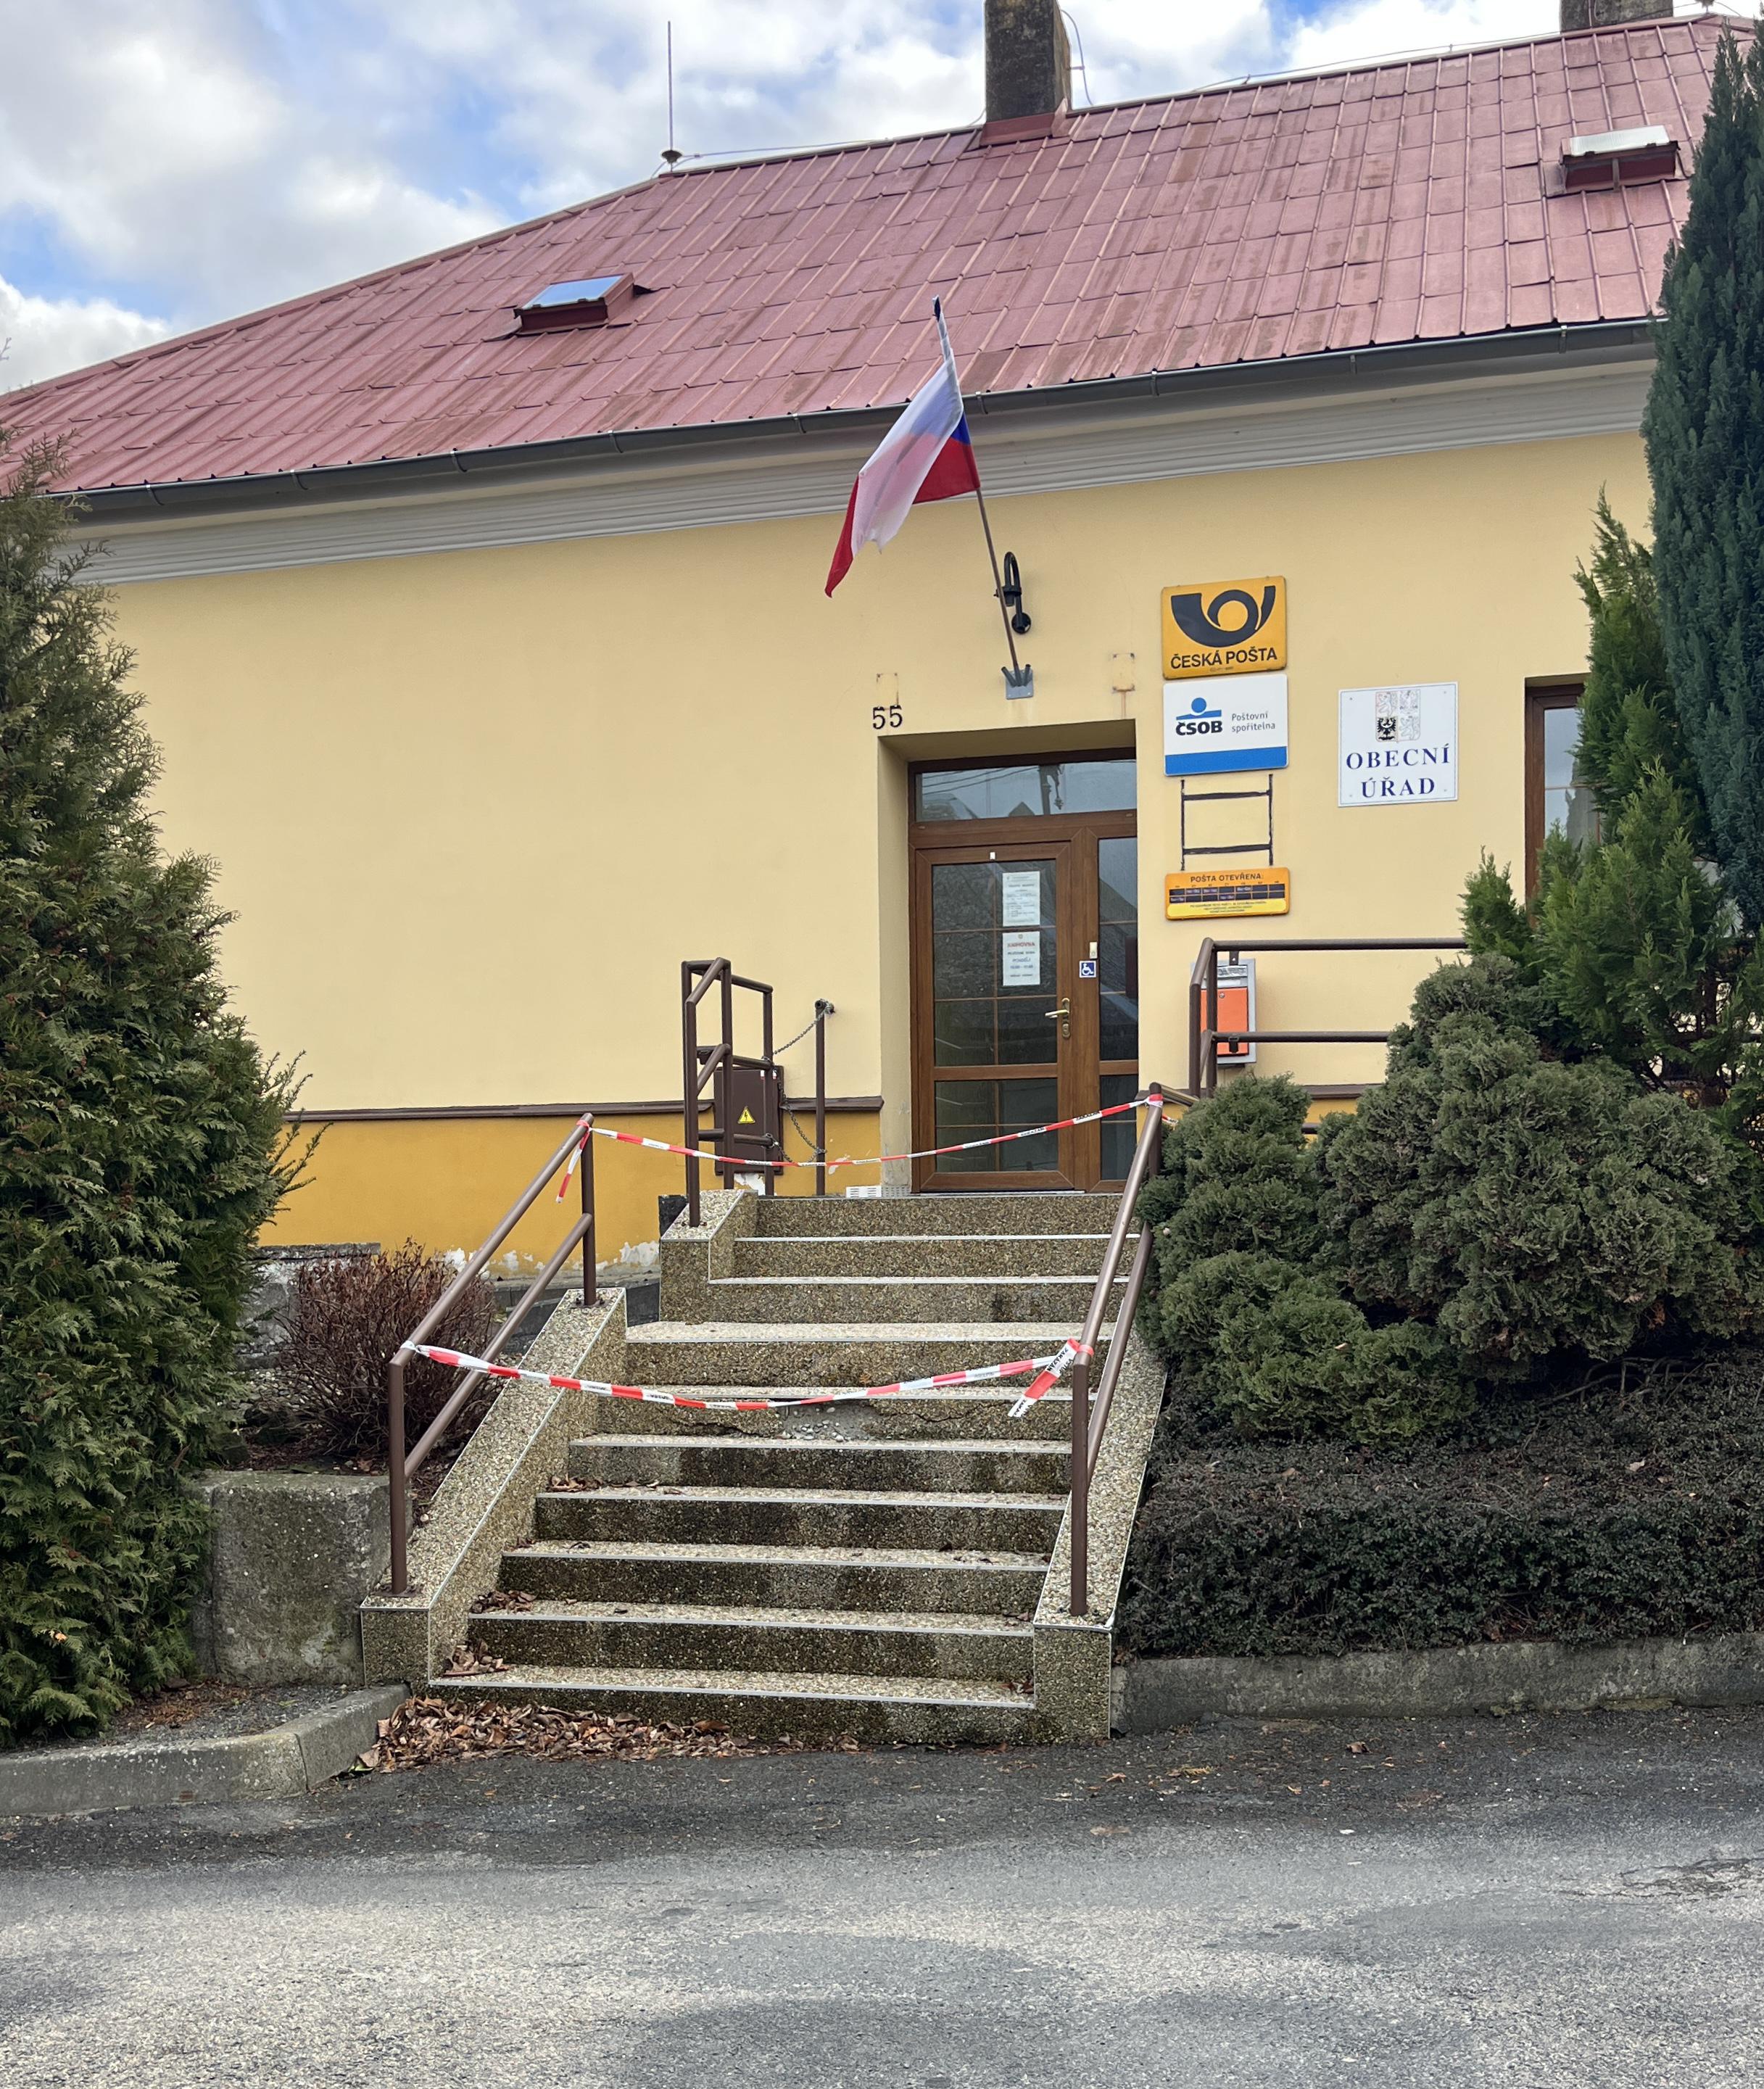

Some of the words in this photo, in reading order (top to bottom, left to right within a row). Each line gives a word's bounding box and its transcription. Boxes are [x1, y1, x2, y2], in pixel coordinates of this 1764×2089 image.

[1170, 650, 1222, 669] ČESKÁ
[1226, 646, 1278, 664] POŠTA
[872, 705, 903, 729] 55
[1175, 721, 1223, 736] ČSOB
[1232, 711, 1269, 721] Poštovní
[1232, 722, 1276, 734] spořitelna
[1346, 743, 1450, 769] OBECNÍ
[1361, 777, 1435, 798] ÚŘAD
[1219, 872, 1262, 882] OTEVŘENA
